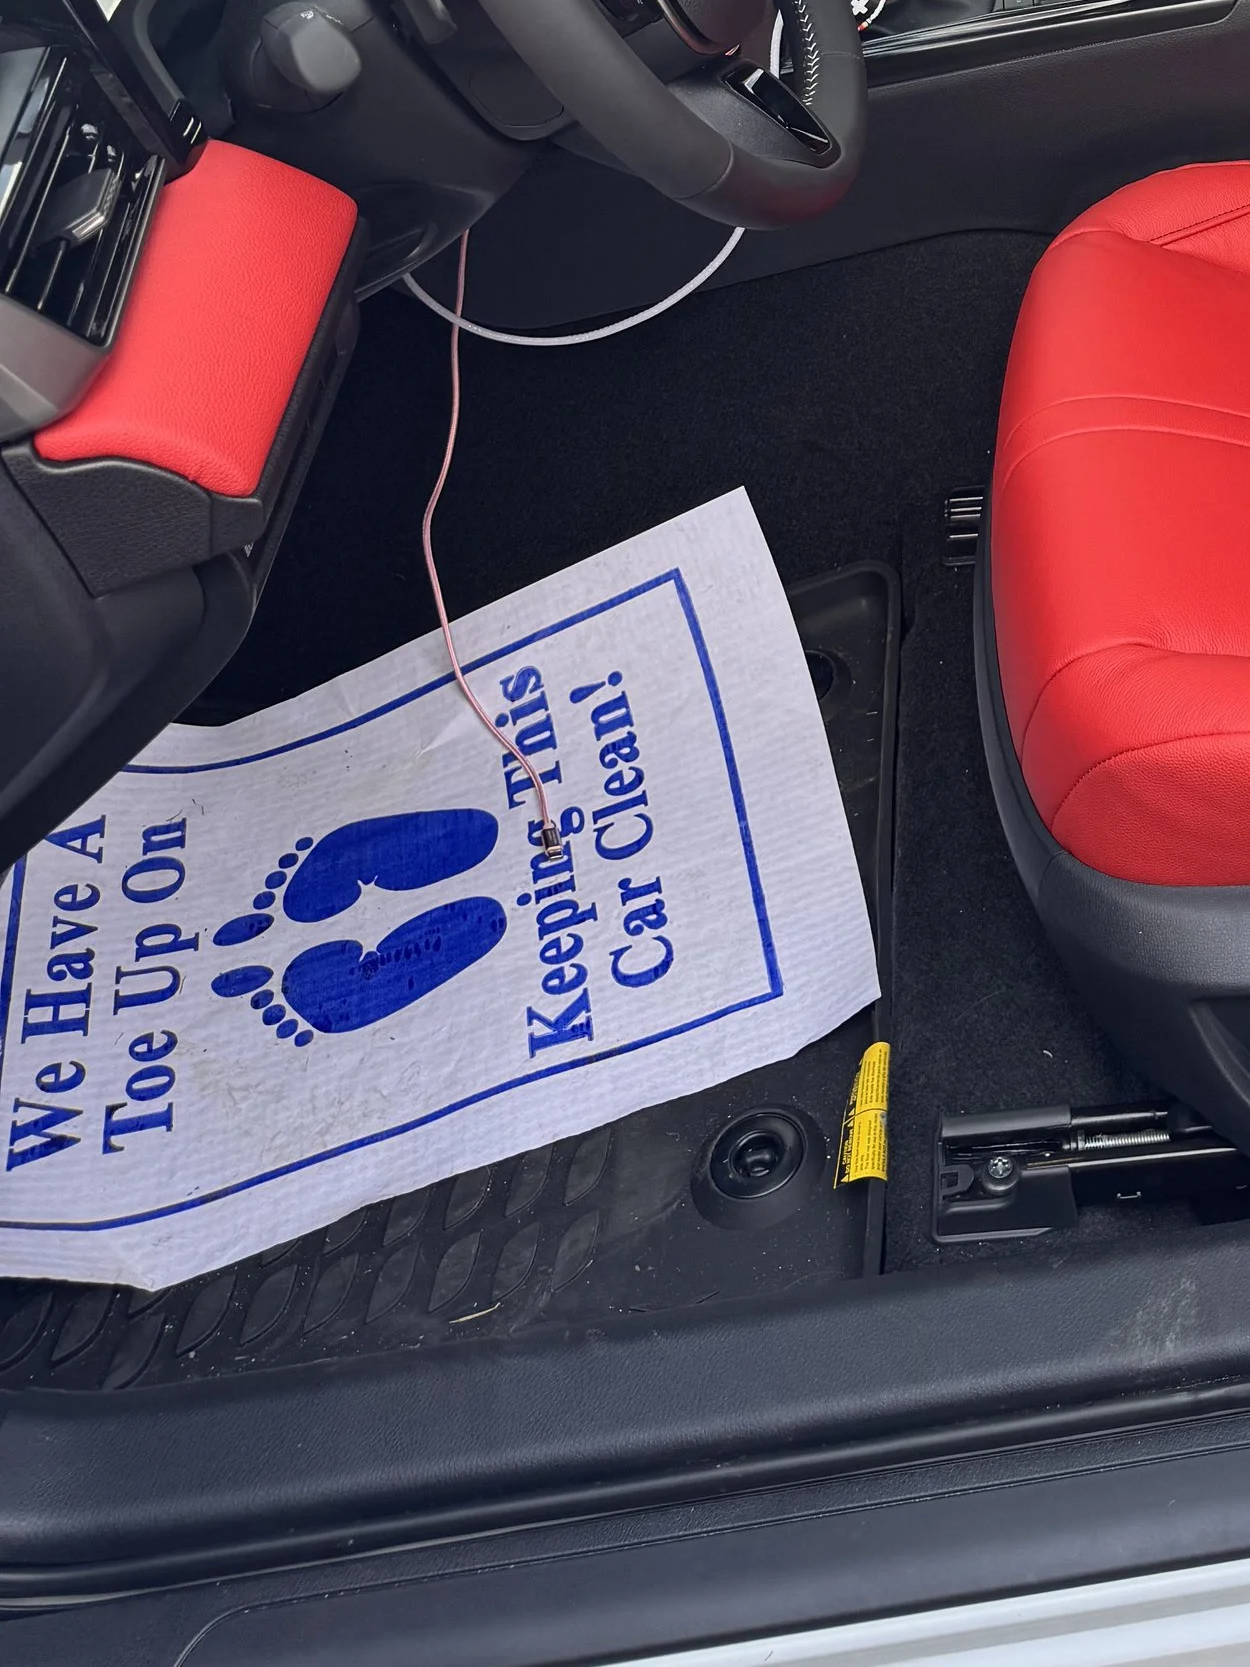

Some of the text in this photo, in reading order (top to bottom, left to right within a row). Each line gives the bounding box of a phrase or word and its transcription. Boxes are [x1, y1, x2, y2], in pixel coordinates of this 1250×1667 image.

[6, 815, 106, 1172] We Have A
[102, 818, 200, 1155] Toe Up On
[495, 665, 598, 1058] Keeping This
[569, 671, 674, 988] Car Clean!
